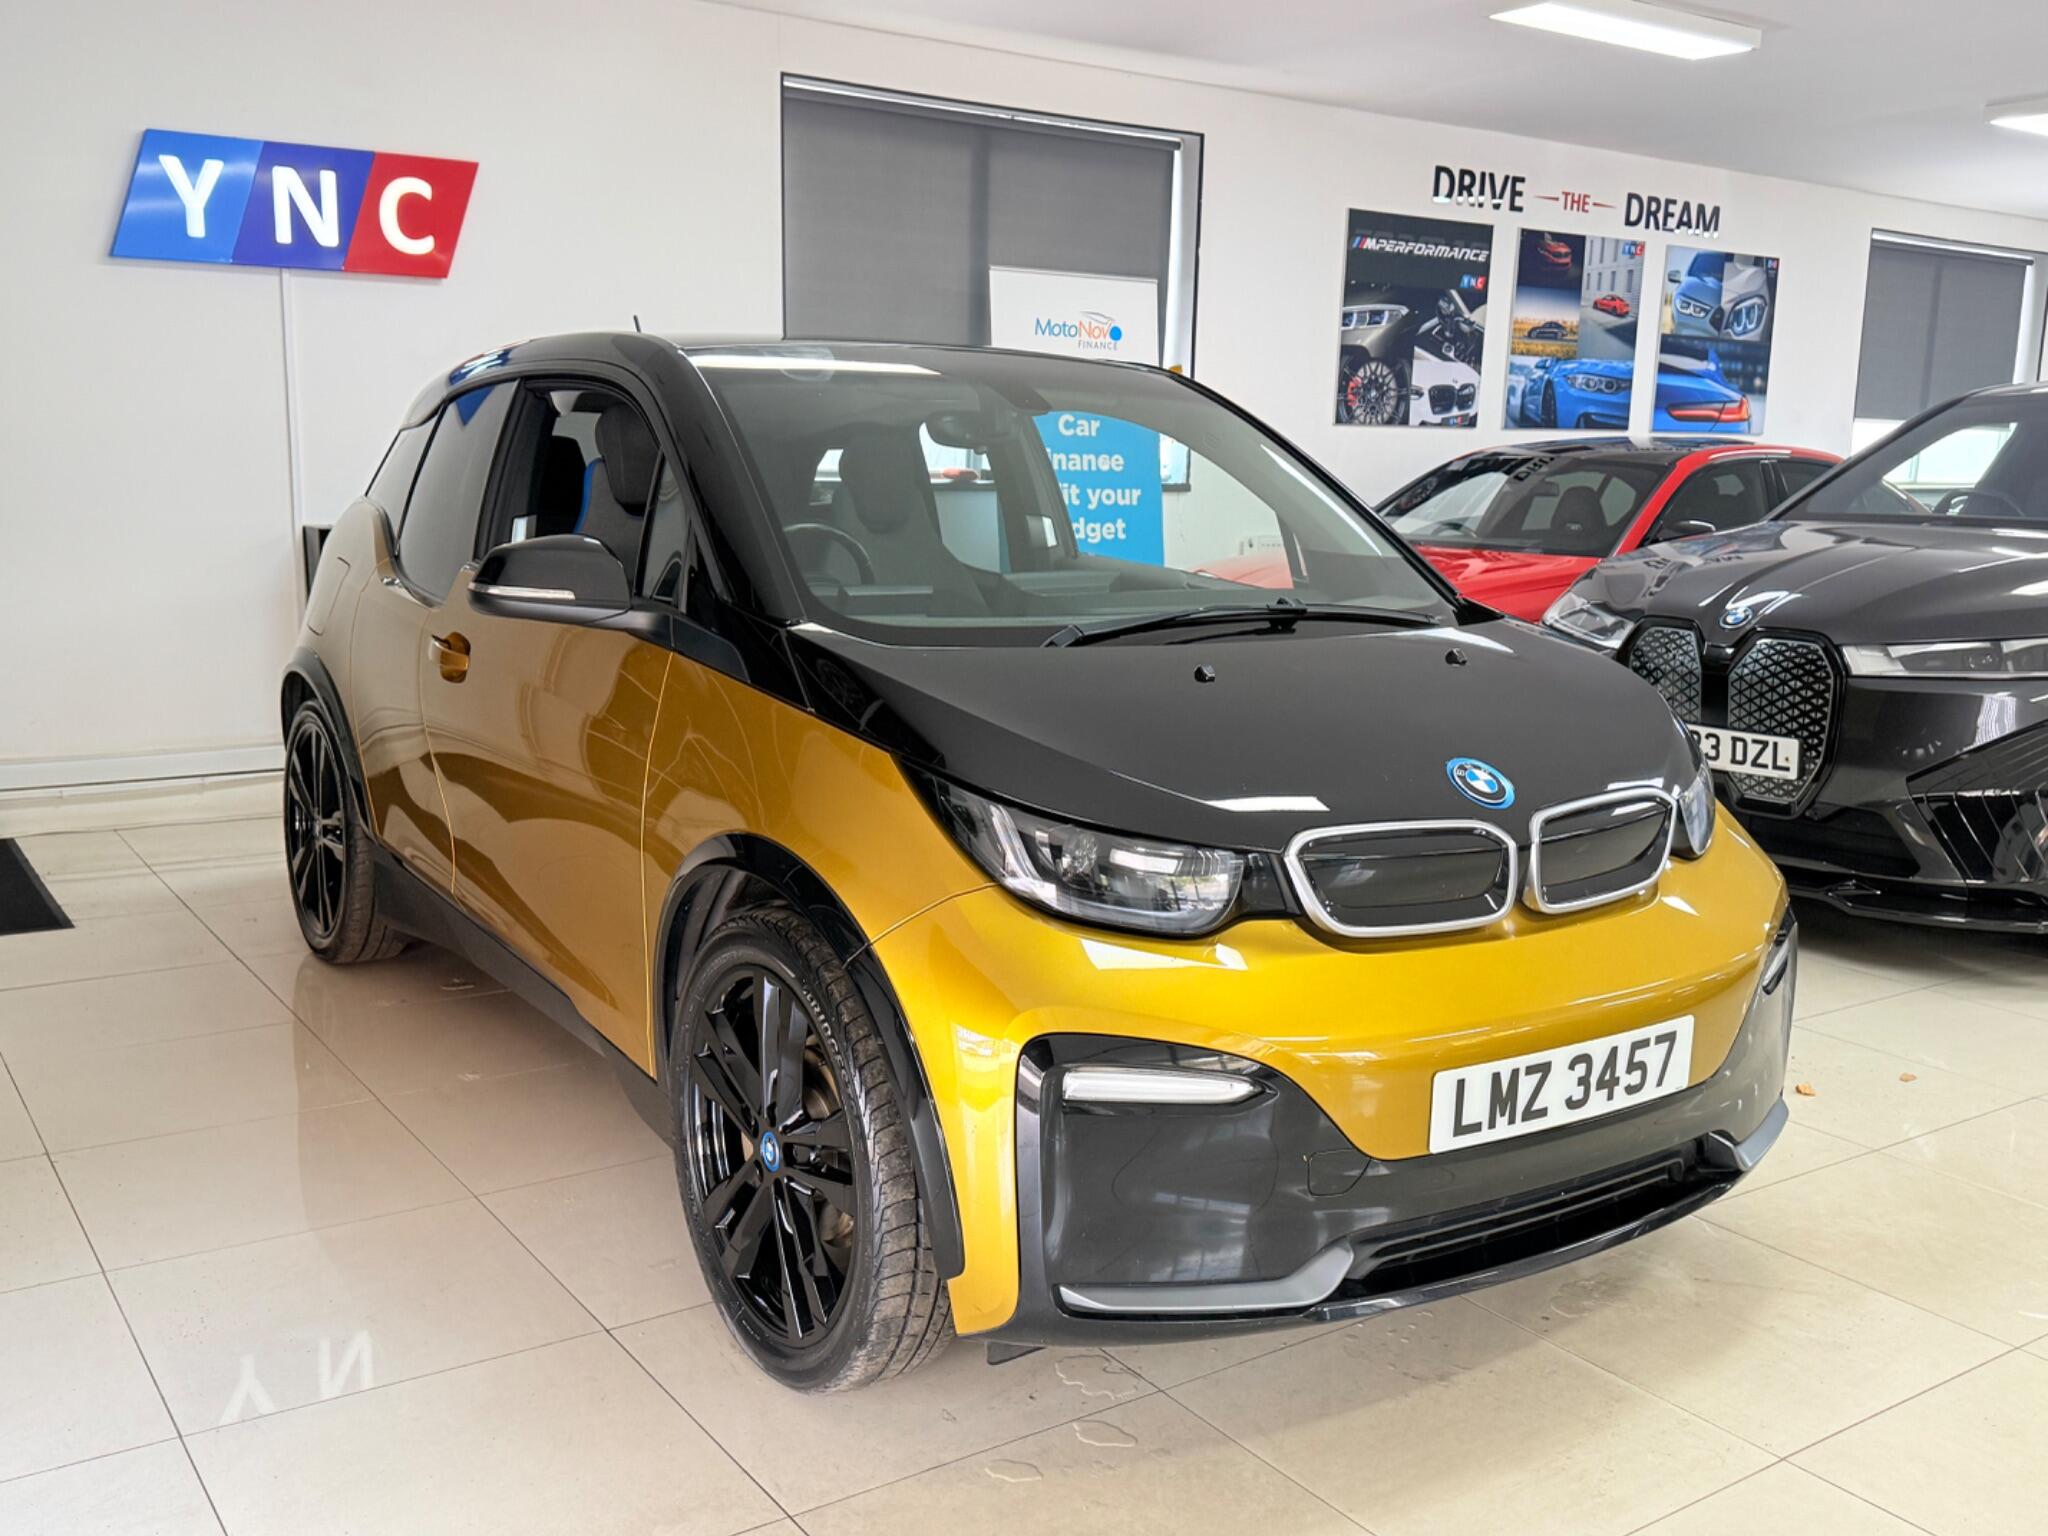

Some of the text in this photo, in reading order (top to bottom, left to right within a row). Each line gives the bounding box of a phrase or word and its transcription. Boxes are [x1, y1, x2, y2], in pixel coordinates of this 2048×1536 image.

[158, 154, 436, 255] YNC
[1432, 165, 1721, 239] DRIVE THE DREAM
[1078, 340, 1118, 351] FINANCE
[1058, 414, 1100, 436] Car
[1086, 488, 1142, 510] your
[1730, 736, 1791, 772] DZL
[1453, 1030, 1677, 1137] LMZ 3457
